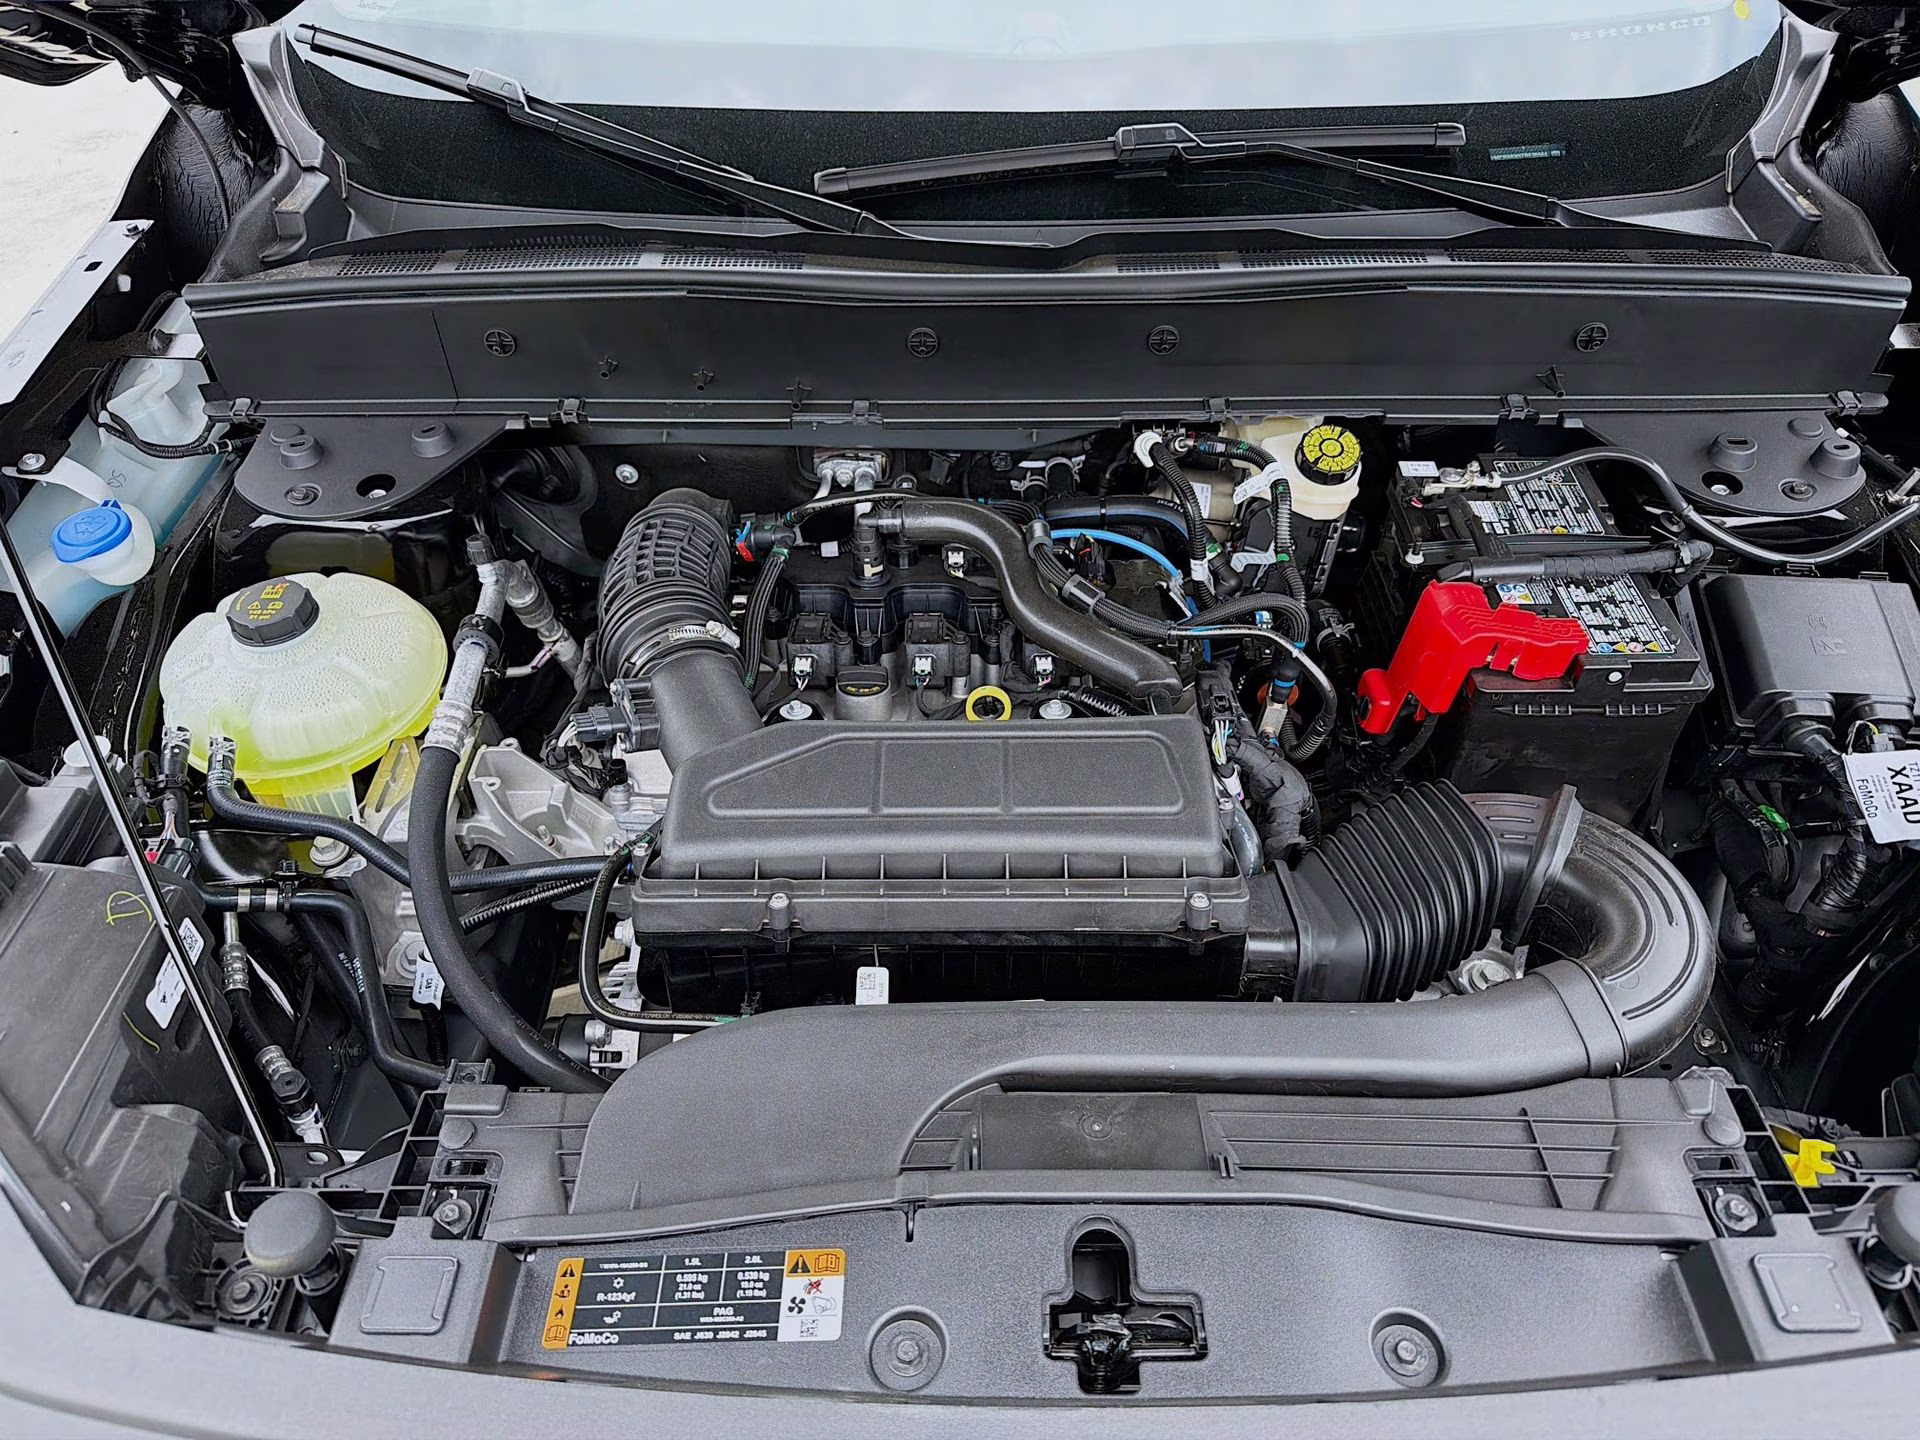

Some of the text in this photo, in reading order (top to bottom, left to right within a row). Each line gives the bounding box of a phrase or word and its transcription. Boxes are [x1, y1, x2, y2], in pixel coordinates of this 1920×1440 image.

[1856, 779, 1878, 818] FoMoCo
[1887, 766, 1920, 824] XAAD
[684, 1257, 702, 1266] 1.5L
[744, 1255, 763, 1264] 2.0L
[698, 1273, 709, 1283] kg
[759, 1271, 770, 1281] kg
[596, 1291, 637, 1303] R-1234yf
[713, 1307, 734, 1315] PAG
[568, 1332, 619, 1345] FoMoCo
[673, 1331, 691, 1340] SAE
